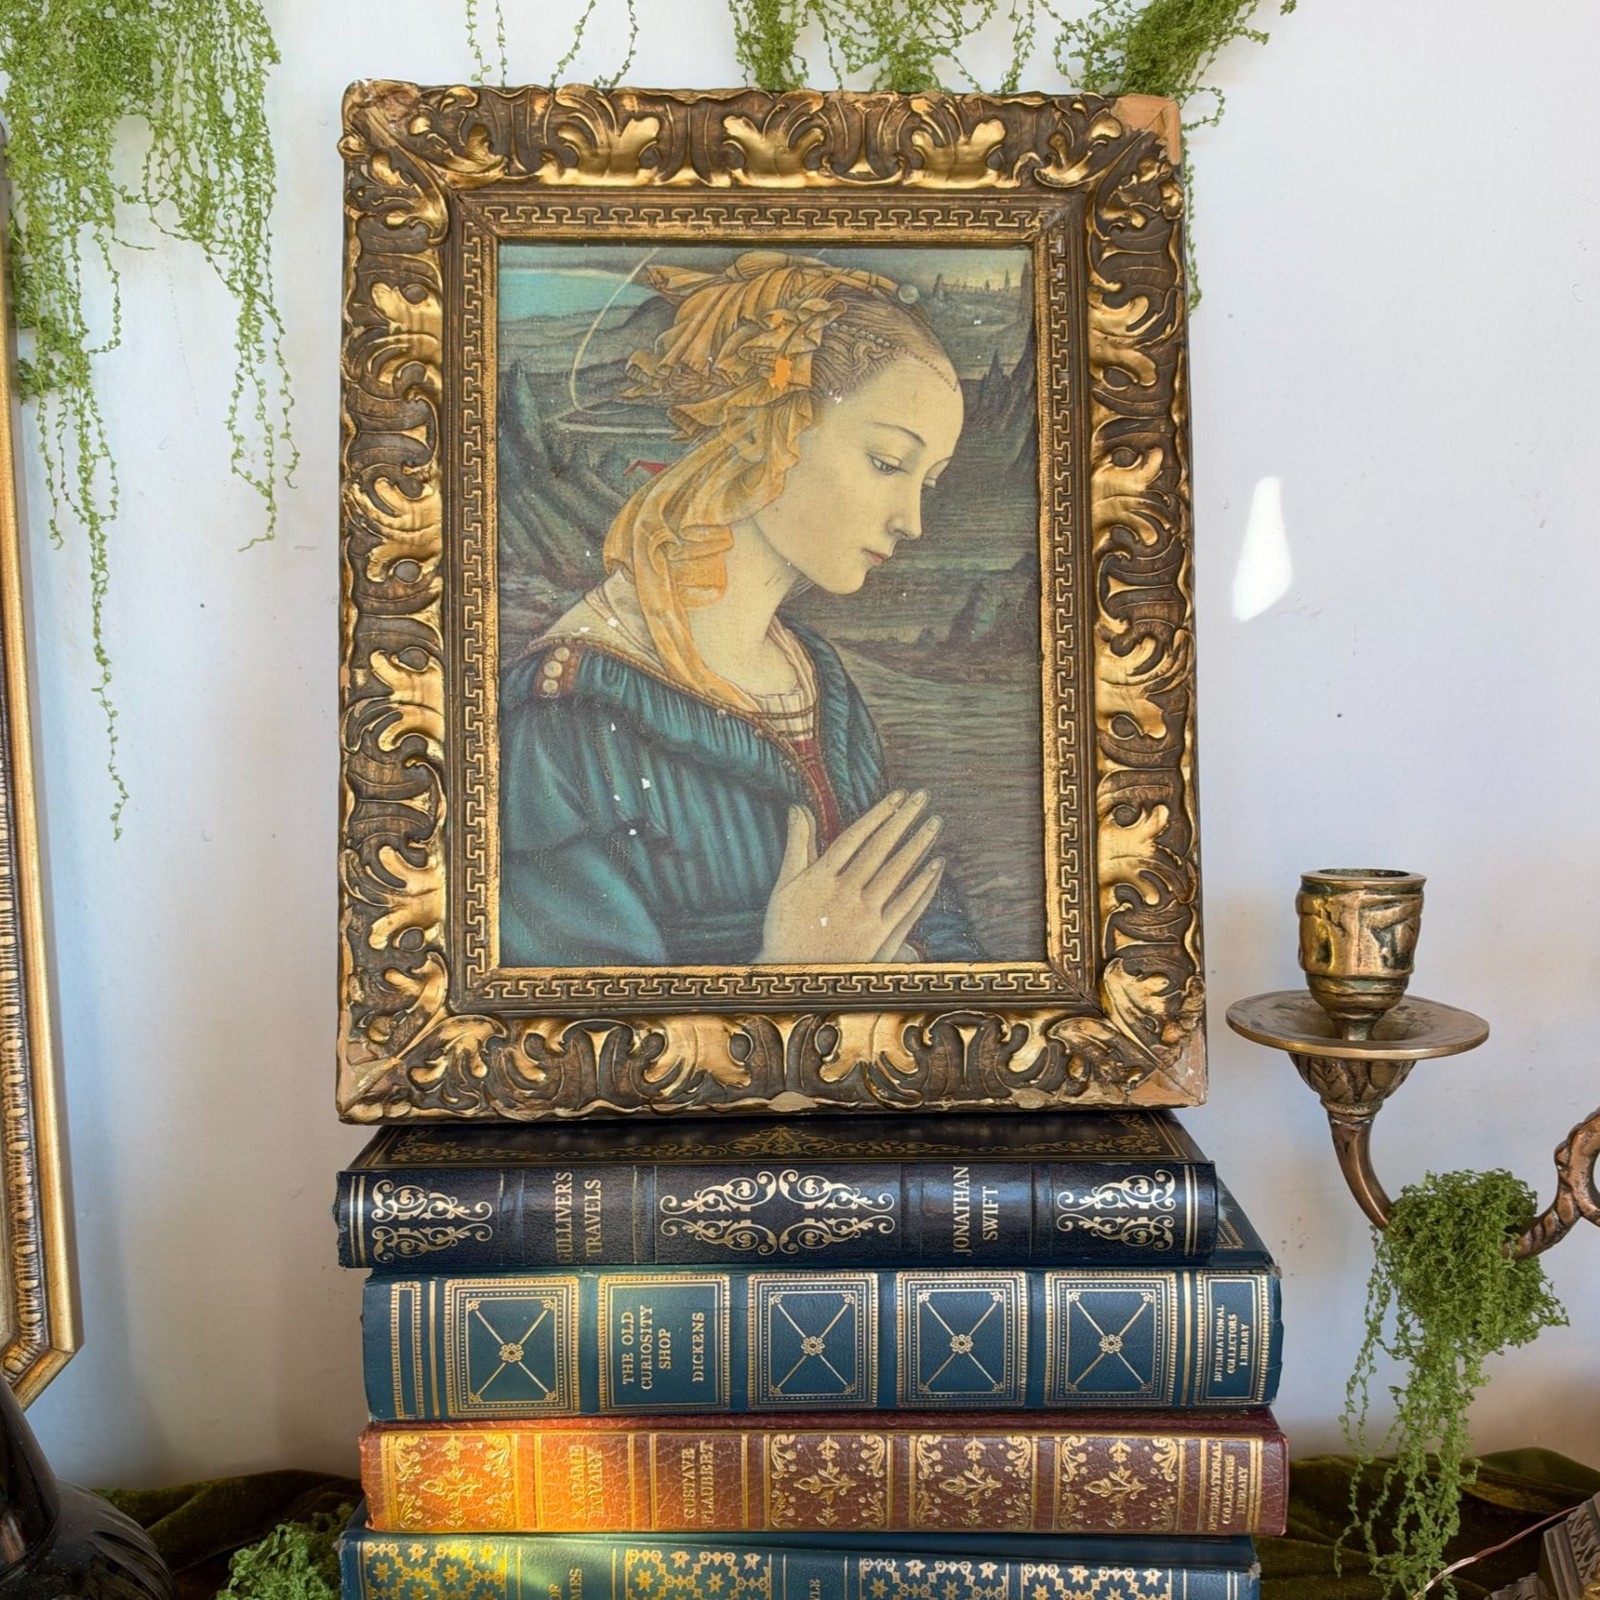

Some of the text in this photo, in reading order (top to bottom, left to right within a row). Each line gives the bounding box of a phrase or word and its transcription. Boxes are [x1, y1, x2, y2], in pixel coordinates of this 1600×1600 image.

[552, 1172, 573, 1263] GULLIVER'S
[584, 1179, 602, 1257] TRAVELS
[953, 1166, 972, 1257] JONATHAN
[982, 1186, 999, 1241] SWIFT
[621, 1312, 634, 1385] THE OLD
[640, 1305, 653, 1390] CURIOSITY
[658, 1328, 671, 1370] SHOP
[692, 1312, 704, 1382] DICKENS
[1214, 1304, 1225, 1382] INTERNATIONAL
[1226, 1313, 1238, 1374] COLLECTORS
[1239, 1323, 1250, 1366] LIBRARY
[681, 1447, 696, 1519] GUSTAVE
[700, 1440, 715, 1525] FLAUBERT
